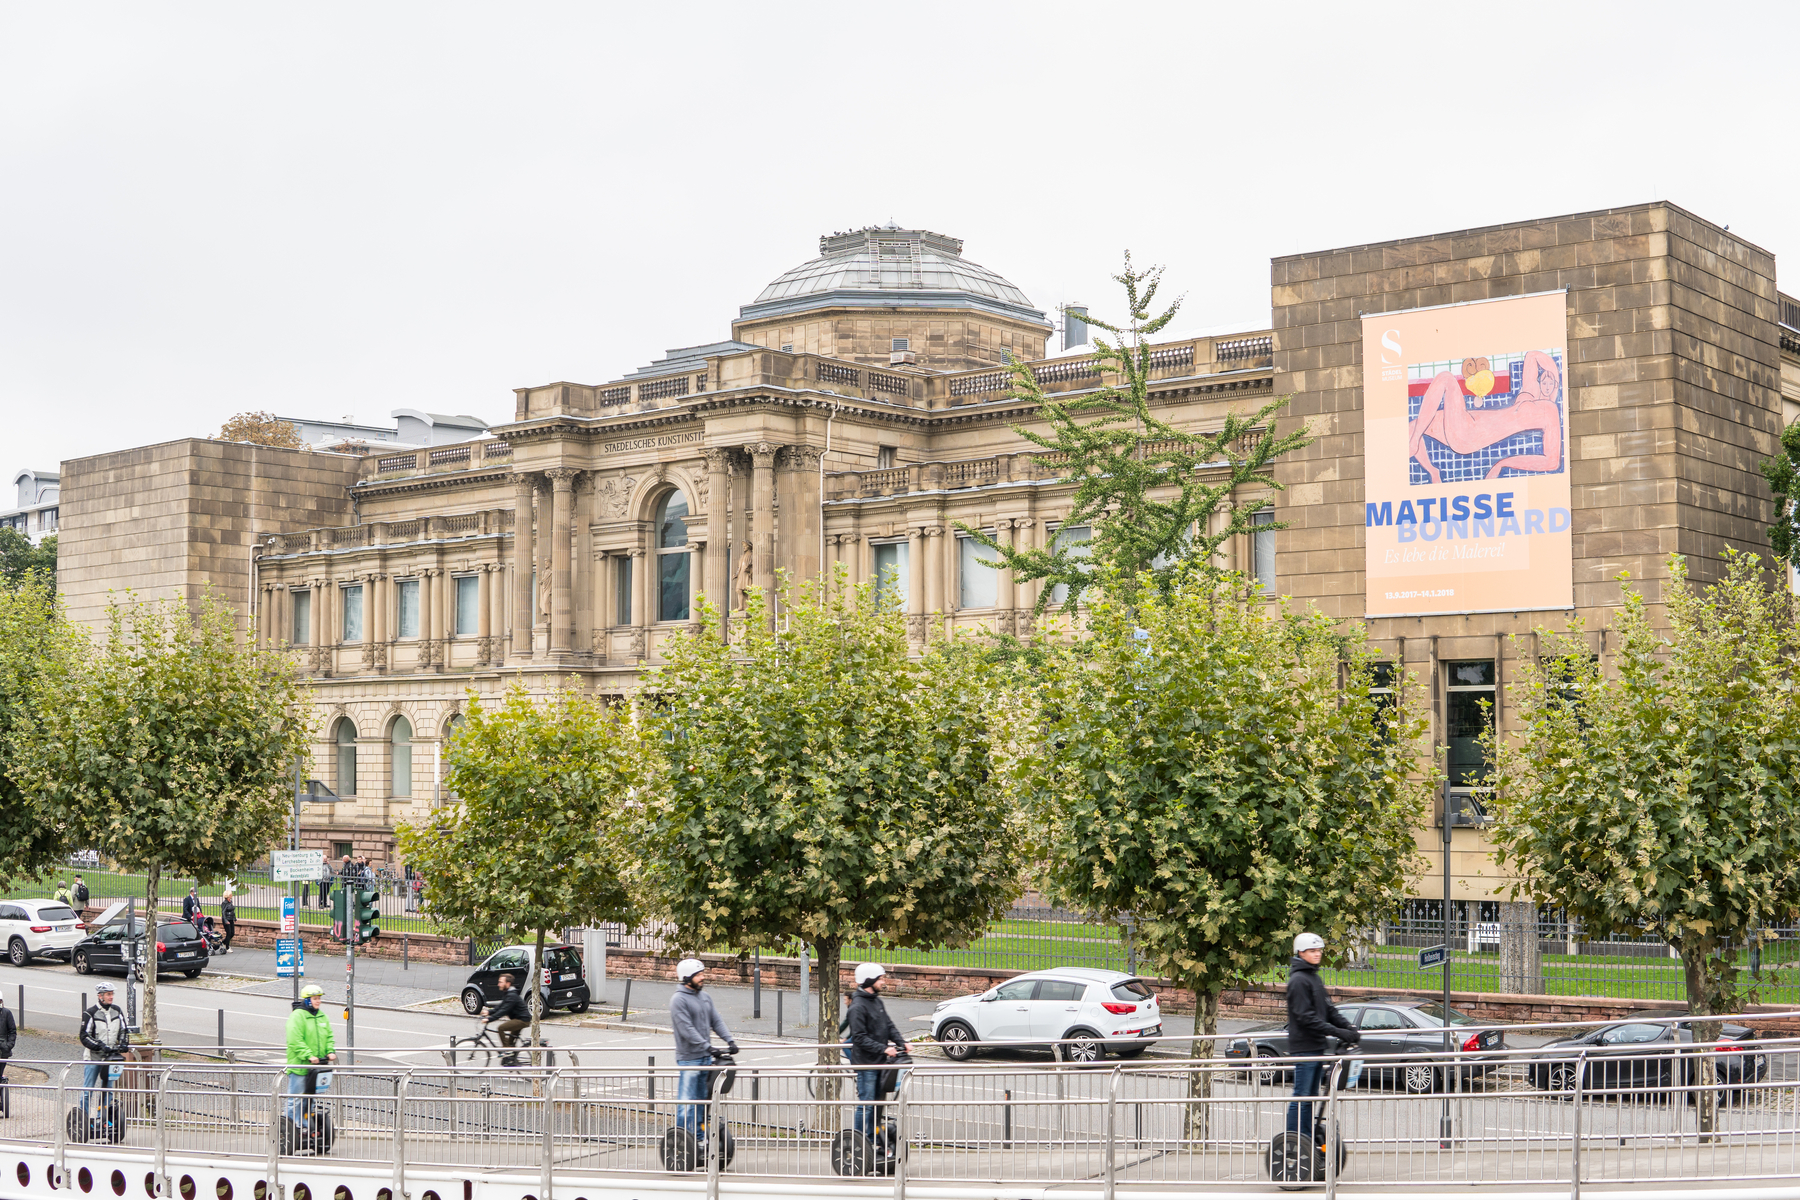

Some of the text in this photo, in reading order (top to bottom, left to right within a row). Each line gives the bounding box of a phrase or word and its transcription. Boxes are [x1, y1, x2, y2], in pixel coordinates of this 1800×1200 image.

[1381, 328, 1403, 364] S
[1381, 369, 1403, 377] STÄDEL
[604, 438, 655, 453] STAEDELSCHES
[1366, 492, 1515, 527] MATISSE
[1397, 506, 1572, 543] BONNARD
[1384, 542, 1505, 564] Es lebe die Malerei!
